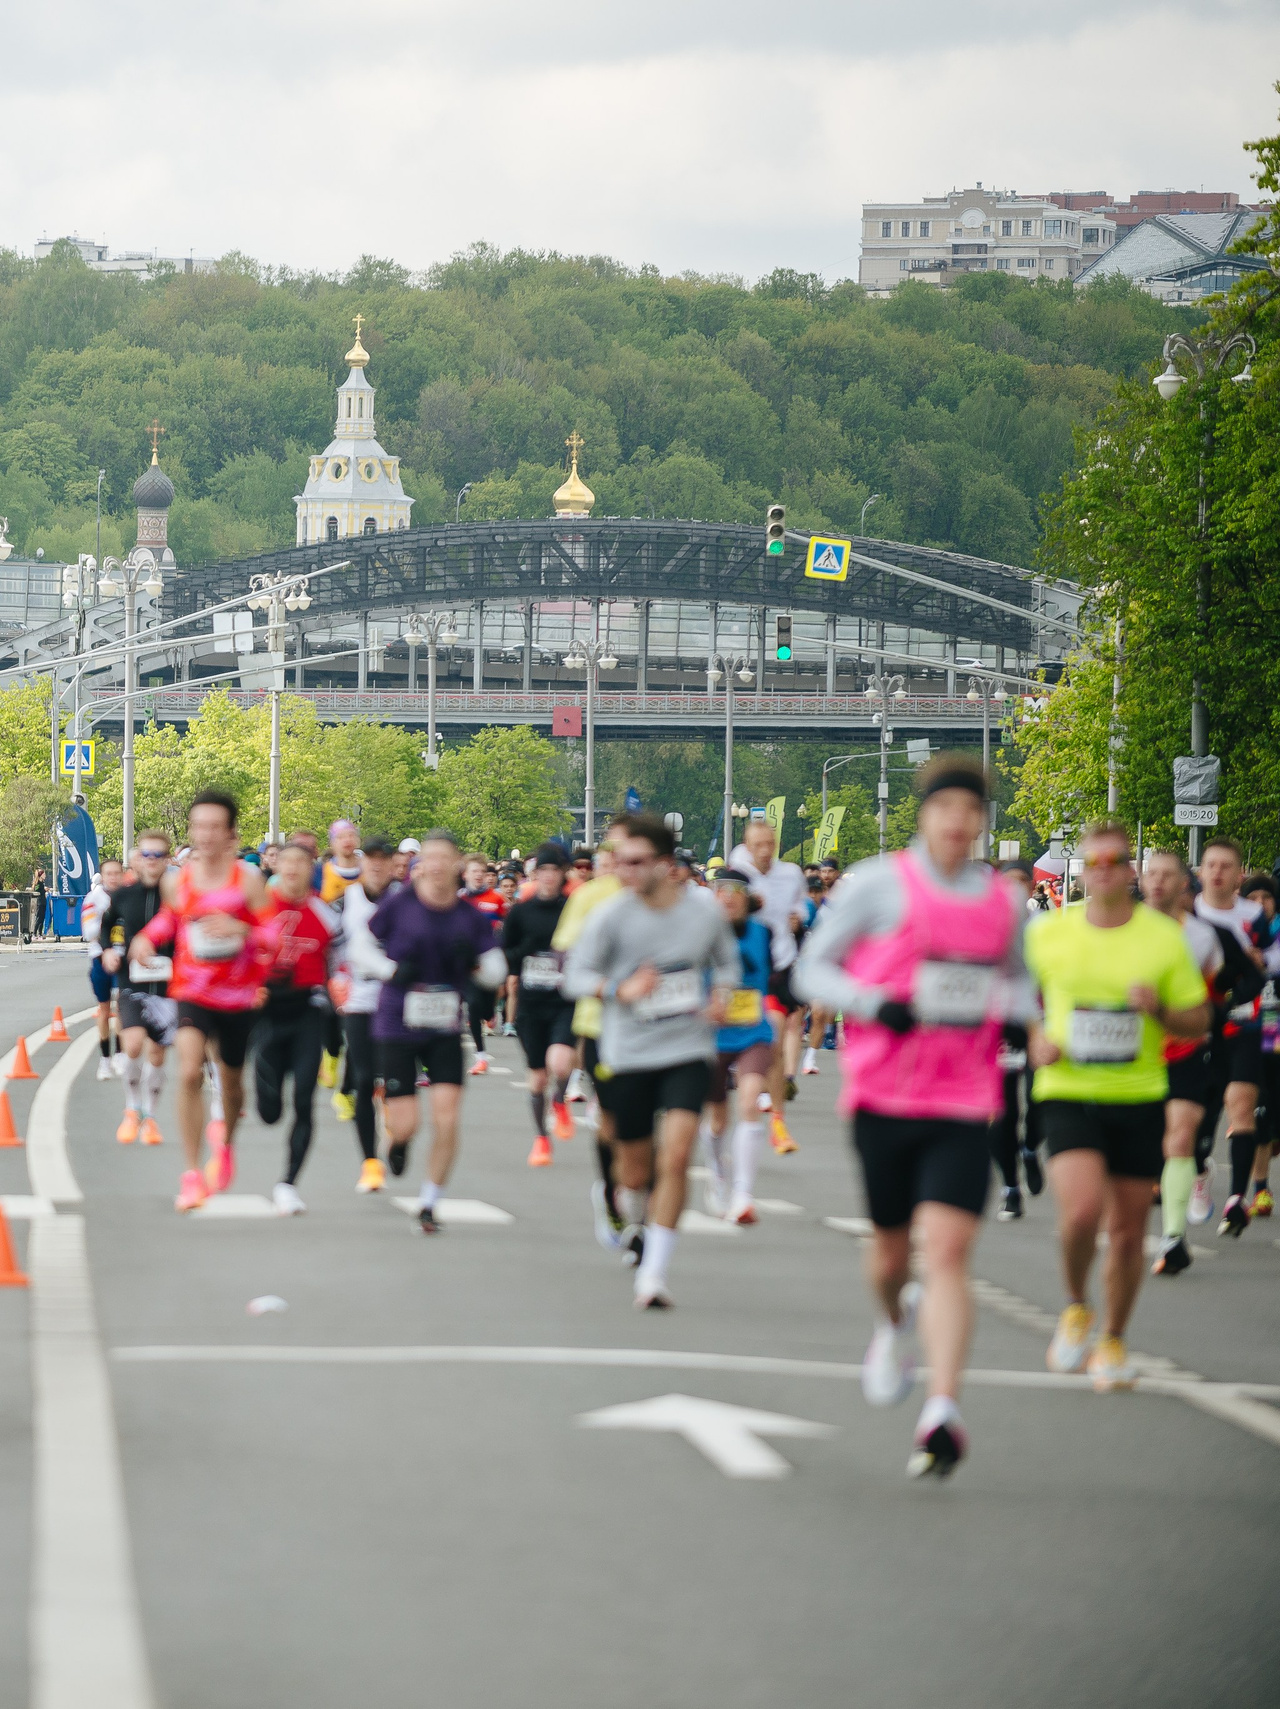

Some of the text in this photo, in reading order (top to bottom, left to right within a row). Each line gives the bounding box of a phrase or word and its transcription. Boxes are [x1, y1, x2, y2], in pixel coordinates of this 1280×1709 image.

[769, 804, 777, 829] UP
[1190, 810, 1198, 818] 15
[1200, 810, 1214, 820] 20
[61, 873, 69, 893] peak
